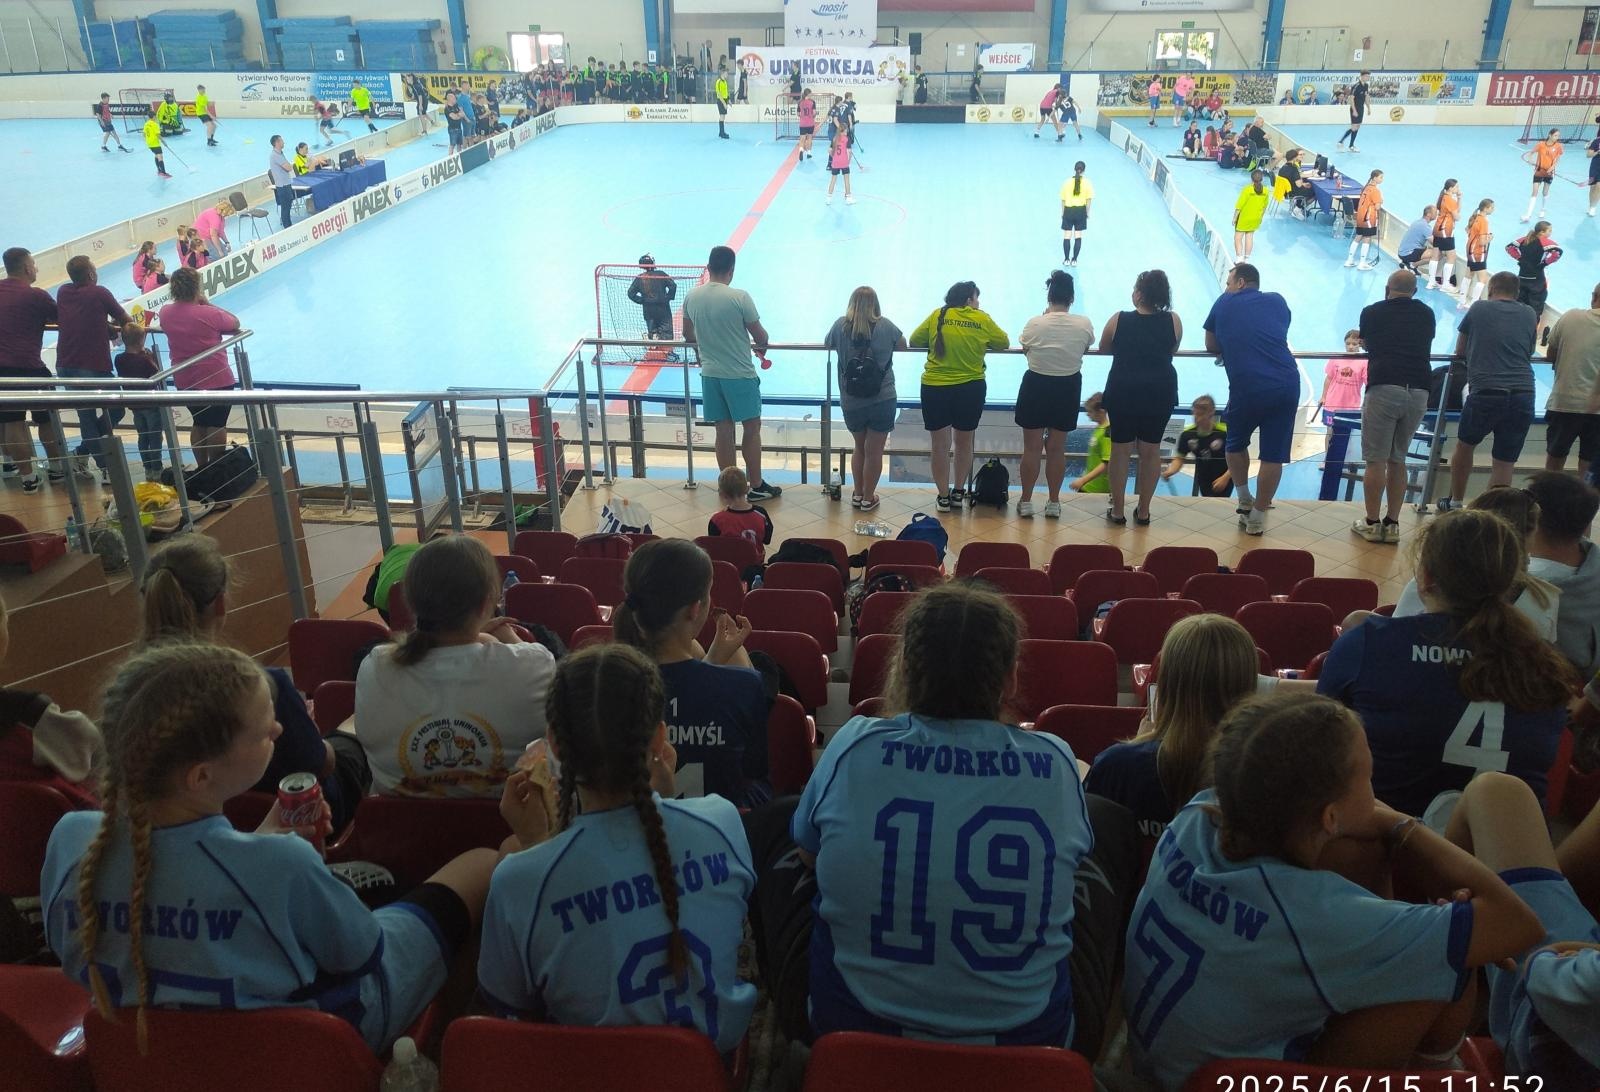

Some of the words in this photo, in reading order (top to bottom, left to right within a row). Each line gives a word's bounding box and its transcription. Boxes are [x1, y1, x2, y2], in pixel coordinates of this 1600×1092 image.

[819, 1, 848, 12] mosir
[770, 59, 875, 76] UNHOKEJA
[805, 48, 840, 56] FESTIWAL
[989, 52, 1022, 64] WEJŚCIE
[1494, 75, 1545, 99] info
[430, 153, 462, 187] HALEX
[353, 184, 392, 223] HALEX
[312, 206, 348, 240] energii
[262, 244, 278, 263] ABB
[200, 249, 259, 297] HALEX
[666, 720, 726, 746] OMYŚL
[1441, 699, 1511, 778] 4
[881, 740, 1053, 779] TWORKÓW
[870, 797, 1057, 972] 19
[1133, 897, 1206, 1050] 7
